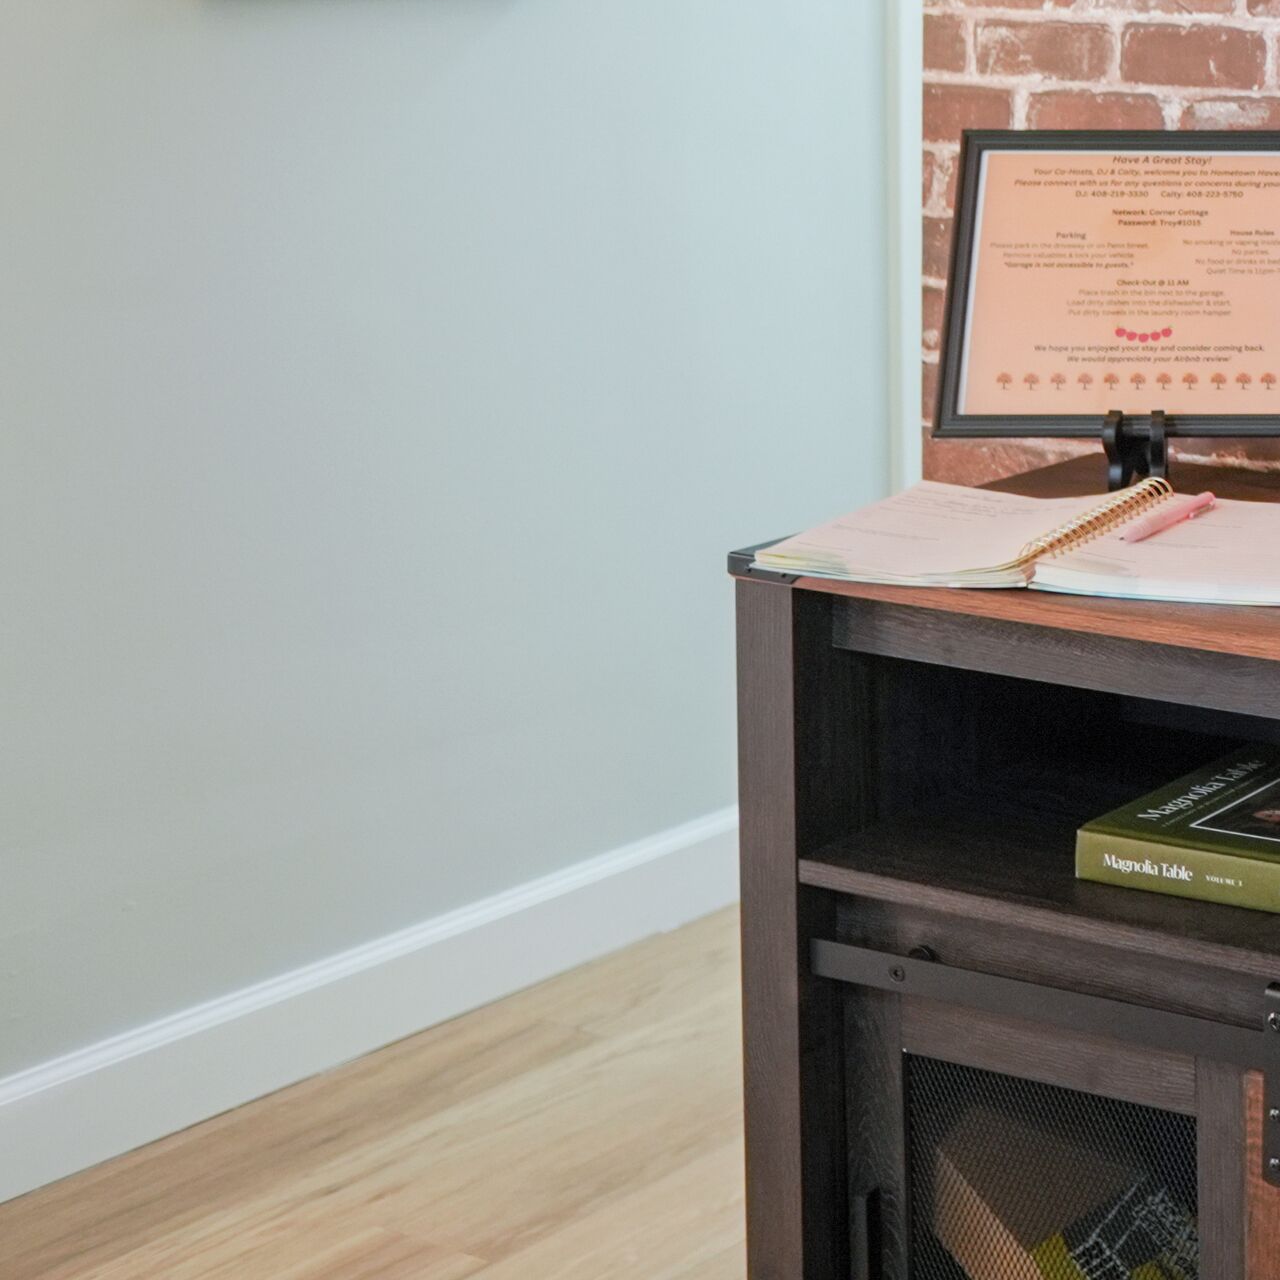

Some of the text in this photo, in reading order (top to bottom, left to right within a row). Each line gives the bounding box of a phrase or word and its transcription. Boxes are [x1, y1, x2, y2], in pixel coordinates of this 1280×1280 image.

[1112, 156, 1212, 167] Have A Great Stay!
[1182, 169, 1197, 178] you
[1014, 179, 1041, 187] Please
[1043, 179, 1077, 187] connect
[1124, 180, 1140, 189] any
[1142, 180, 1181, 189] questions
[1184, 180, 1192, 188] or
[1235, 181, 1261, 190] during
[1178, 209, 1208, 217] Cottage
[1055, 232, 1087, 240] Parking
[1048, 345, 1069, 353] hope
[1071, 345, 1085, 353] you
[1088, 345, 1120, 353] enjoyed
[1121, 345, 1139, 353] your
[1141, 345, 1158, 353] stay
[1213, 345, 1242, 353] coming
[1107, 356, 1152, 364] appreciate
[1153, 356, 1171, 364] your
[1137, 780, 1227, 821] Magnolia
[1103, 853, 1159, 876] Magnolia
[1160, 863, 1194, 882] Table
[1205, 874, 1235, 886] VOLUME
